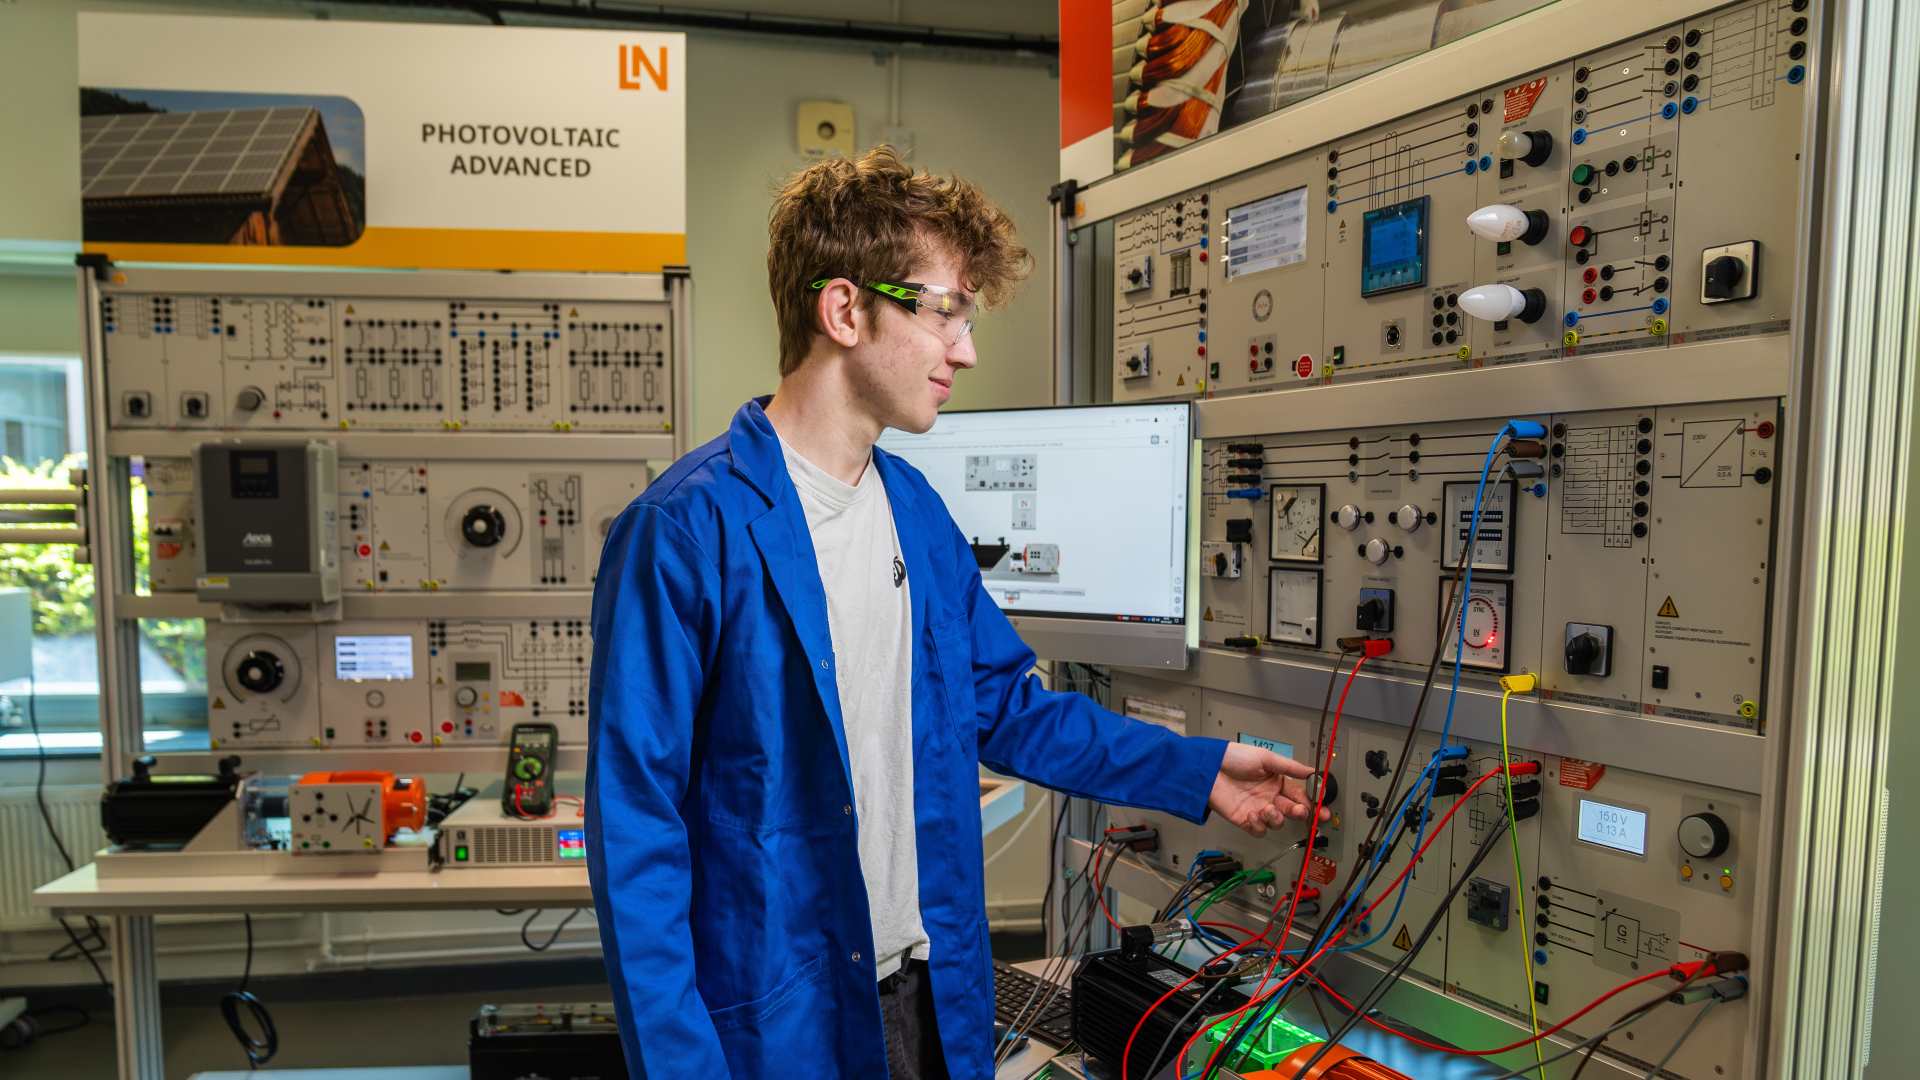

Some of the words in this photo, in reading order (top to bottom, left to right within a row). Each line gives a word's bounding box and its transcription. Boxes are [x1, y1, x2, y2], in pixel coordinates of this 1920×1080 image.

[619, 44, 668, 91] LN
[421, 123, 620, 148] PHOTOVOLTAIC
[450, 155, 591, 177] ADVANCED
[1620, 816, 1628, 825] V
[1619, 828, 1627, 839] A
[1617, 924, 1627, 937] G
